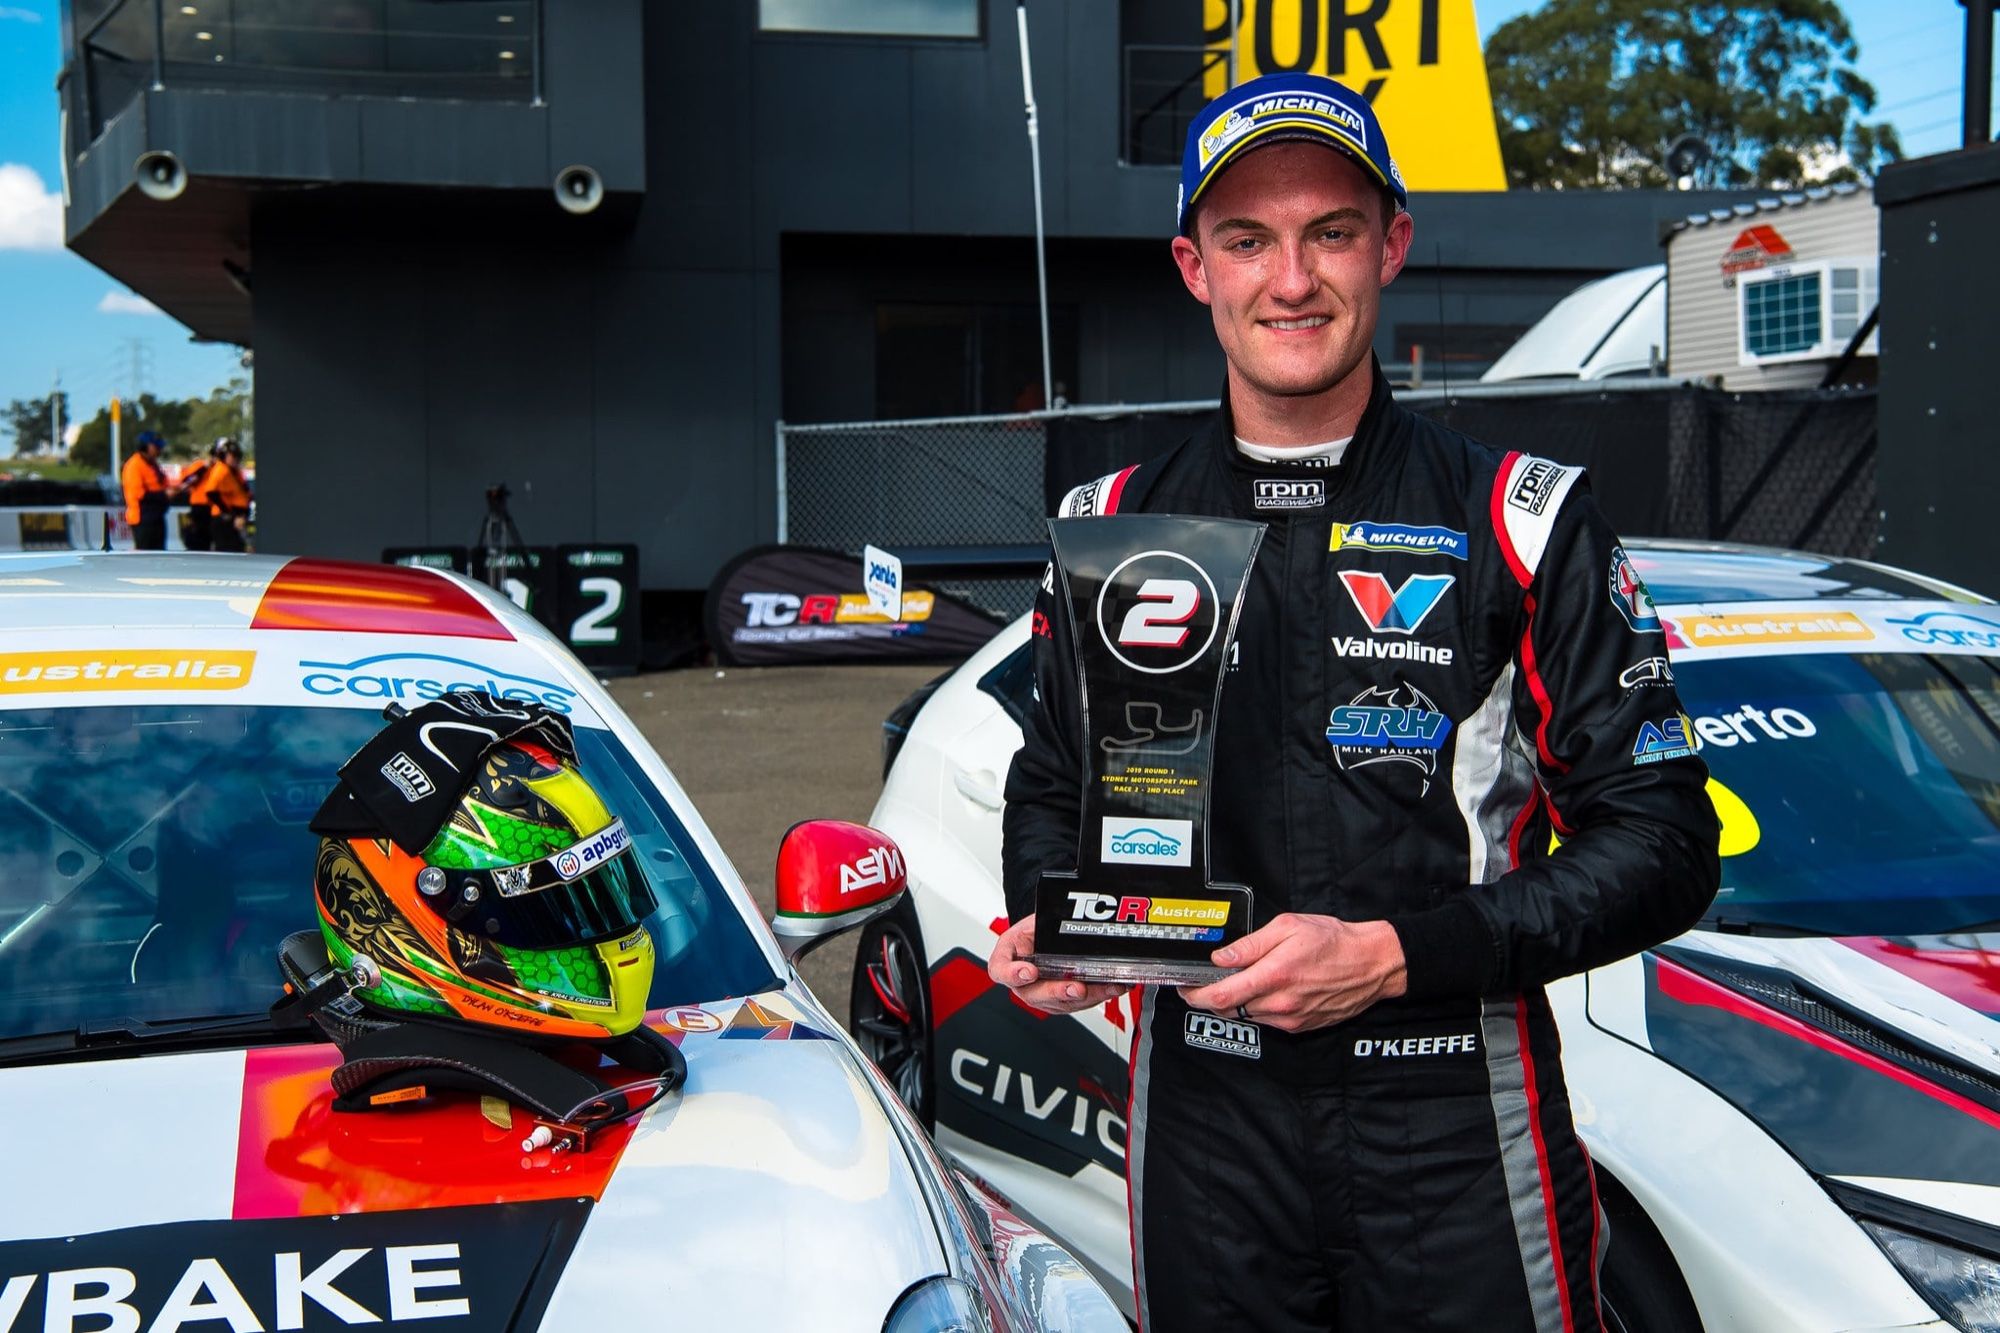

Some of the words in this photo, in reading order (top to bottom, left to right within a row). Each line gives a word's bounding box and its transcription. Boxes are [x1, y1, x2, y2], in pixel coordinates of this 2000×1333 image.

[1252, 98, 1360, 131] MICHELIN
[1260, 482, 1320, 499] rpm
[1514, 463, 1549, 504] rpm
[1258, 497, 1323, 507] RACEWEAR
[1369, 532, 1459, 549] MICHELIN
[1610, 557, 1620, 594] ALFA
[571, 576, 624, 644] 2
[741, 592, 839, 628] TCR
[1118, 578, 1201, 648] 2
[1694, 618, 1865, 638] Australia
[1331, 636, 1454, 666] Valvoline
[0, 660, 242, 683] ustralia
[1326, 704, 1451, 749] SRH
[1694, 704, 1817, 752] erto
[1342, 746, 1373, 754] MILK
[393, 756, 431, 795] rpm
[1101, 775, 1129, 783] SYDNEY
[1131, 776, 1177, 785] MOTORSPORT
[1111, 841, 1179, 857] carsales
[839, 846, 906, 895] ASM
[1067, 891, 1151, 923] TCR
[1152, 905, 1226, 920] Australia
[1065, 923, 1105, 935] Touring
[1107, 926, 1127, 935] Car
[1128, 927, 1166, 937] Series
[676, 1010, 710, 1030] E
[1189, 1014, 1256, 1045] rpm
[1186, 1034, 1259, 1054] RACEWEAR
[1354, 1034, 1476, 1057] O'KEEFFE
[950, 1048, 1127, 1158] CIVIC
